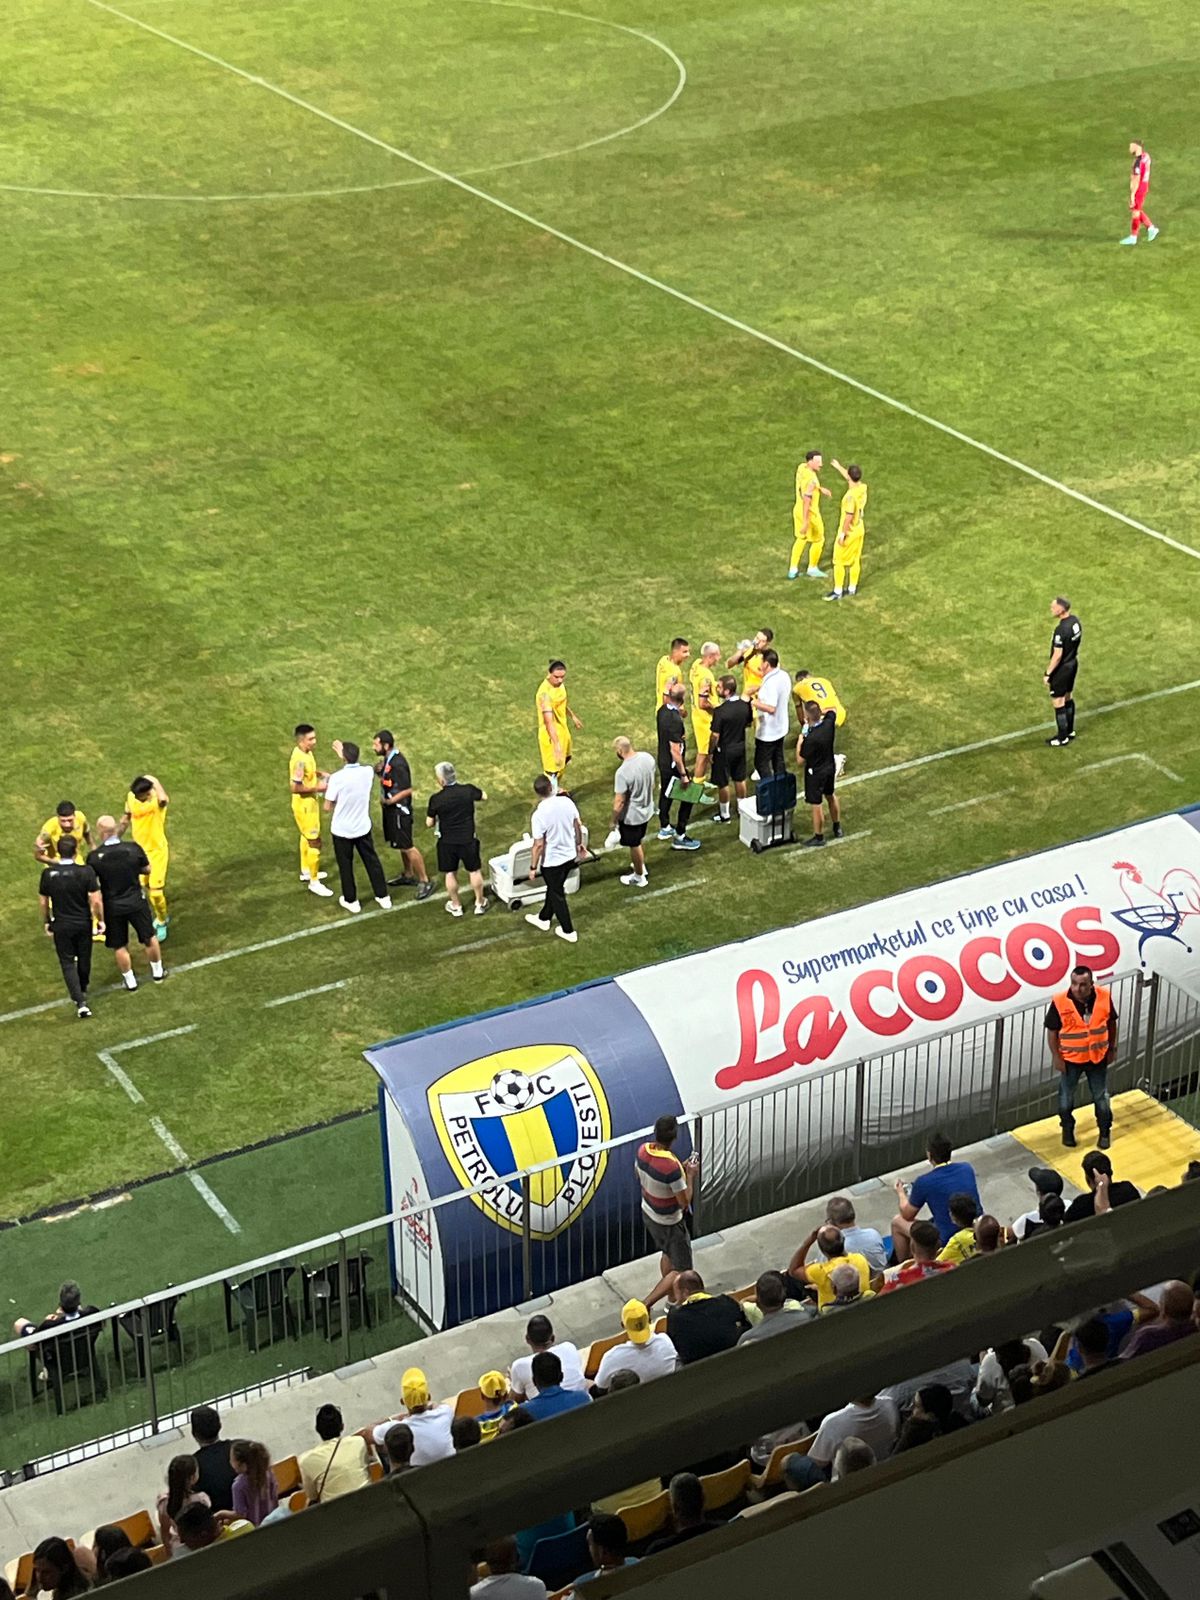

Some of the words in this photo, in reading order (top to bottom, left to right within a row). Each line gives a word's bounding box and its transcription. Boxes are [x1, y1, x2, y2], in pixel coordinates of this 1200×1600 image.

[811, 682, 827, 699] 9
[782, 920, 927, 984] Supermarketul
[931, 918, 955, 938] ce
[1002, 896, 1029, 917] cu
[1030, 882, 1077, 909] casa
[714, 968, 848, 1090] La
[474, 1093, 491, 1115] F
[536, 1075, 556, 1096] C
[449, 1115, 524, 1222] PETROLU
